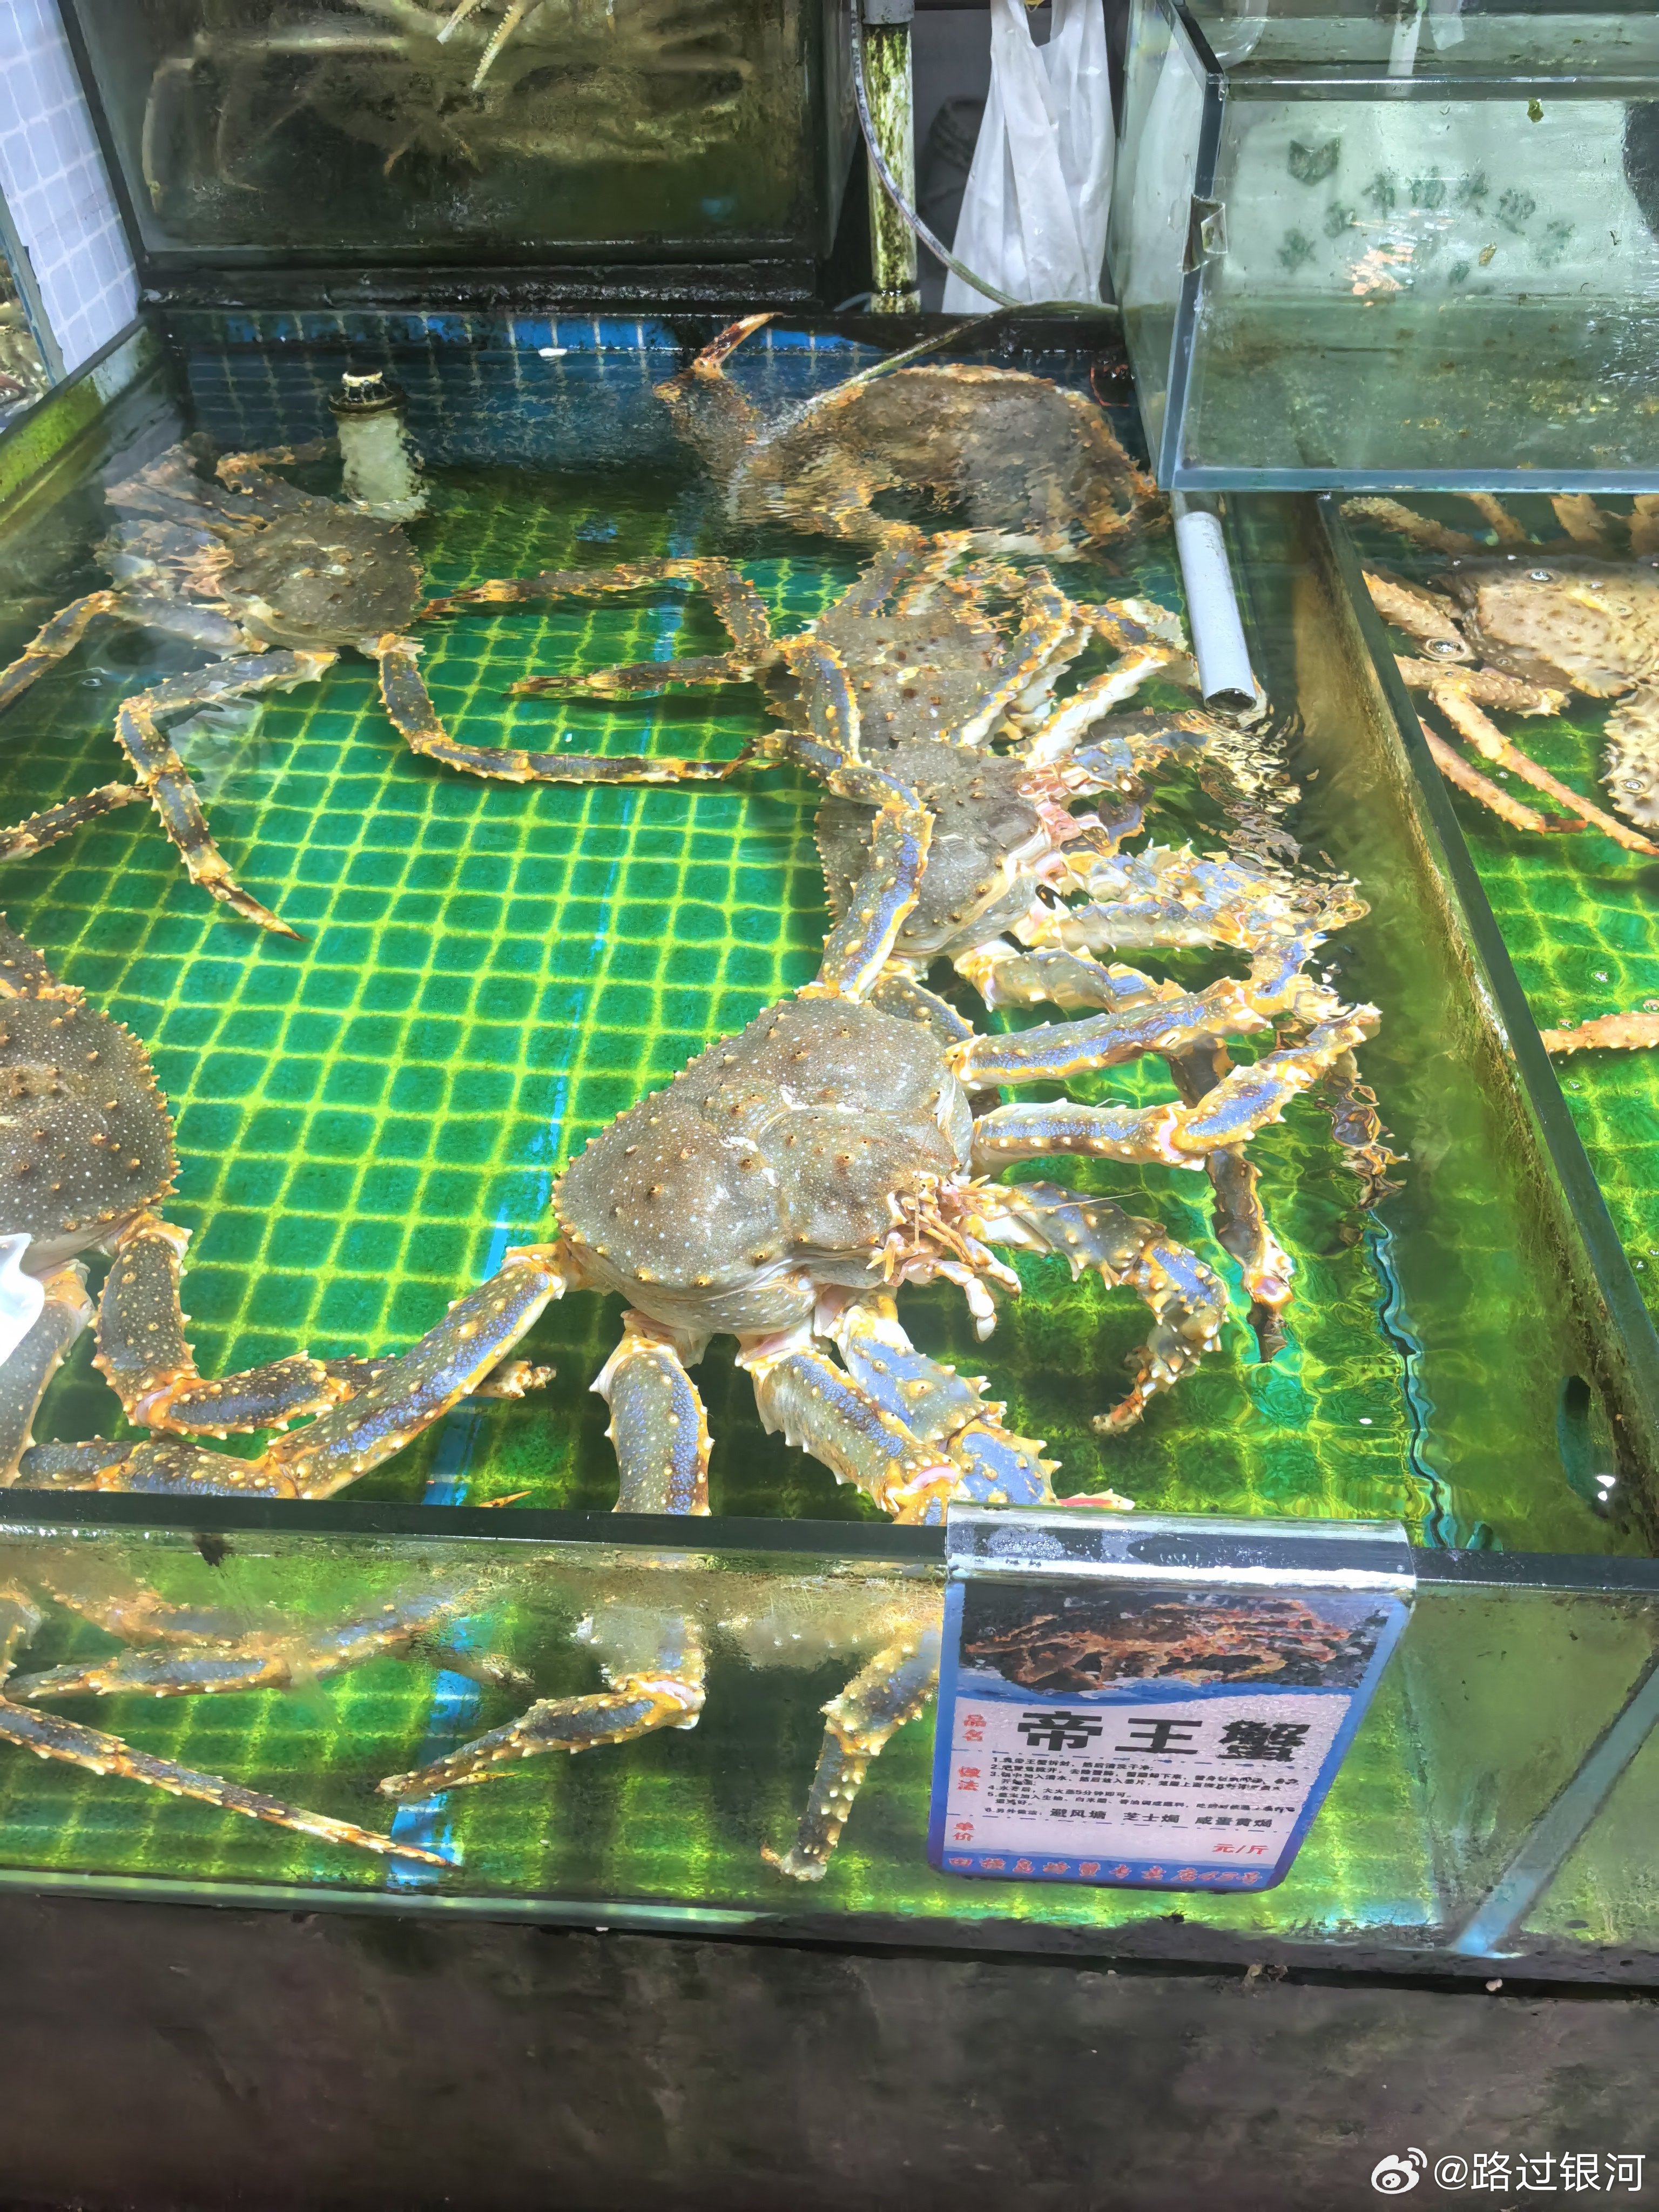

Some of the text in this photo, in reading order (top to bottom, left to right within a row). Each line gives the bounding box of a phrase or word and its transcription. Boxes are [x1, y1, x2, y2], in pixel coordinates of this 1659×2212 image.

[962, 1714, 987, 1742] 品名
[1017, 1711, 1311, 1762] 帝王蟹
[956, 1766, 981, 1791] 做法
[1050, 1808, 1107, 1819] 避风塘
[952, 1822, 976, 1842] 单价
[1211, 1843, 1269, 1854] 元/斤
